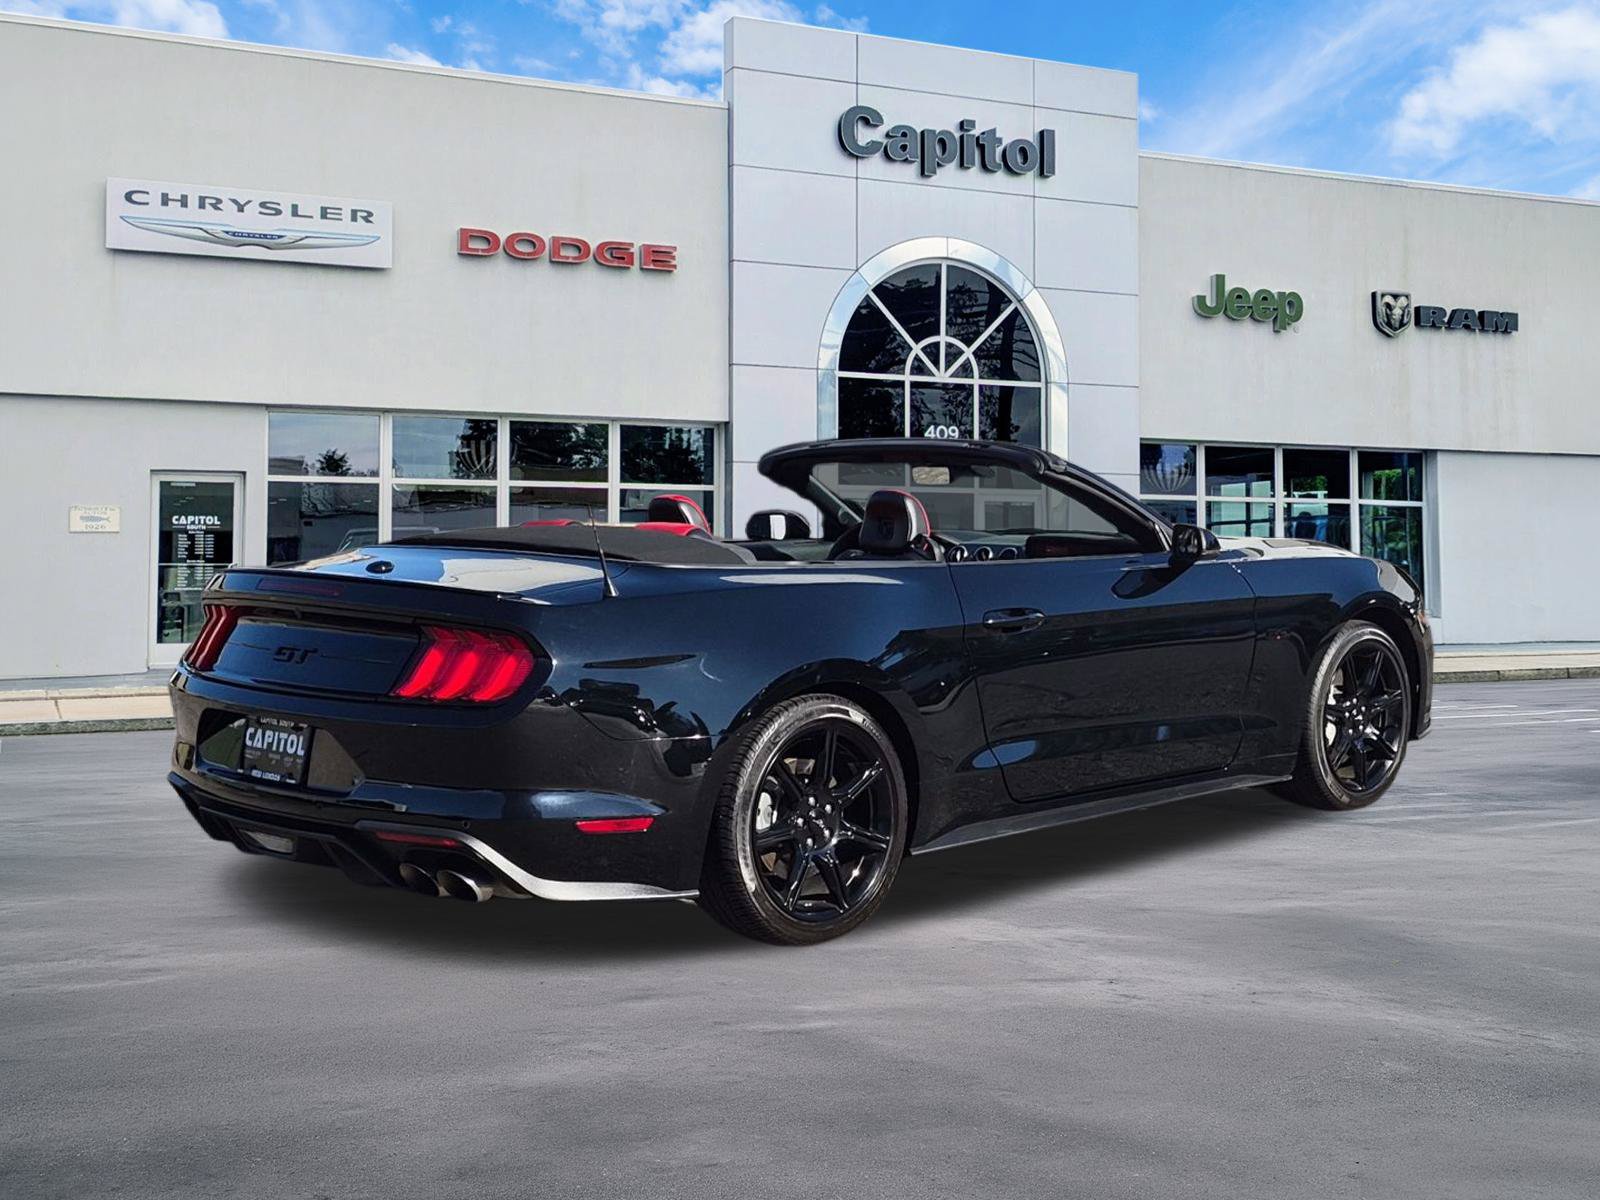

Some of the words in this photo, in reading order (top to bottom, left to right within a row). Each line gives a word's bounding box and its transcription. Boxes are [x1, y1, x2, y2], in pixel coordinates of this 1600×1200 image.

[838, 105, 1056, 177] Capitol
[124, 190, 375, 224] CHRYSLER
[457, 227, 678, 272] DODGE
[1191, 273, 1304, 333] Jeep
[1414, 304, 1519, 333] RAM
[924, 424, 960, 440] 409
[172, 515, 221, 525] CAPITOL
[273, 646, 319, 665] GT
[245, 727, 305, 757] CAPITOL
